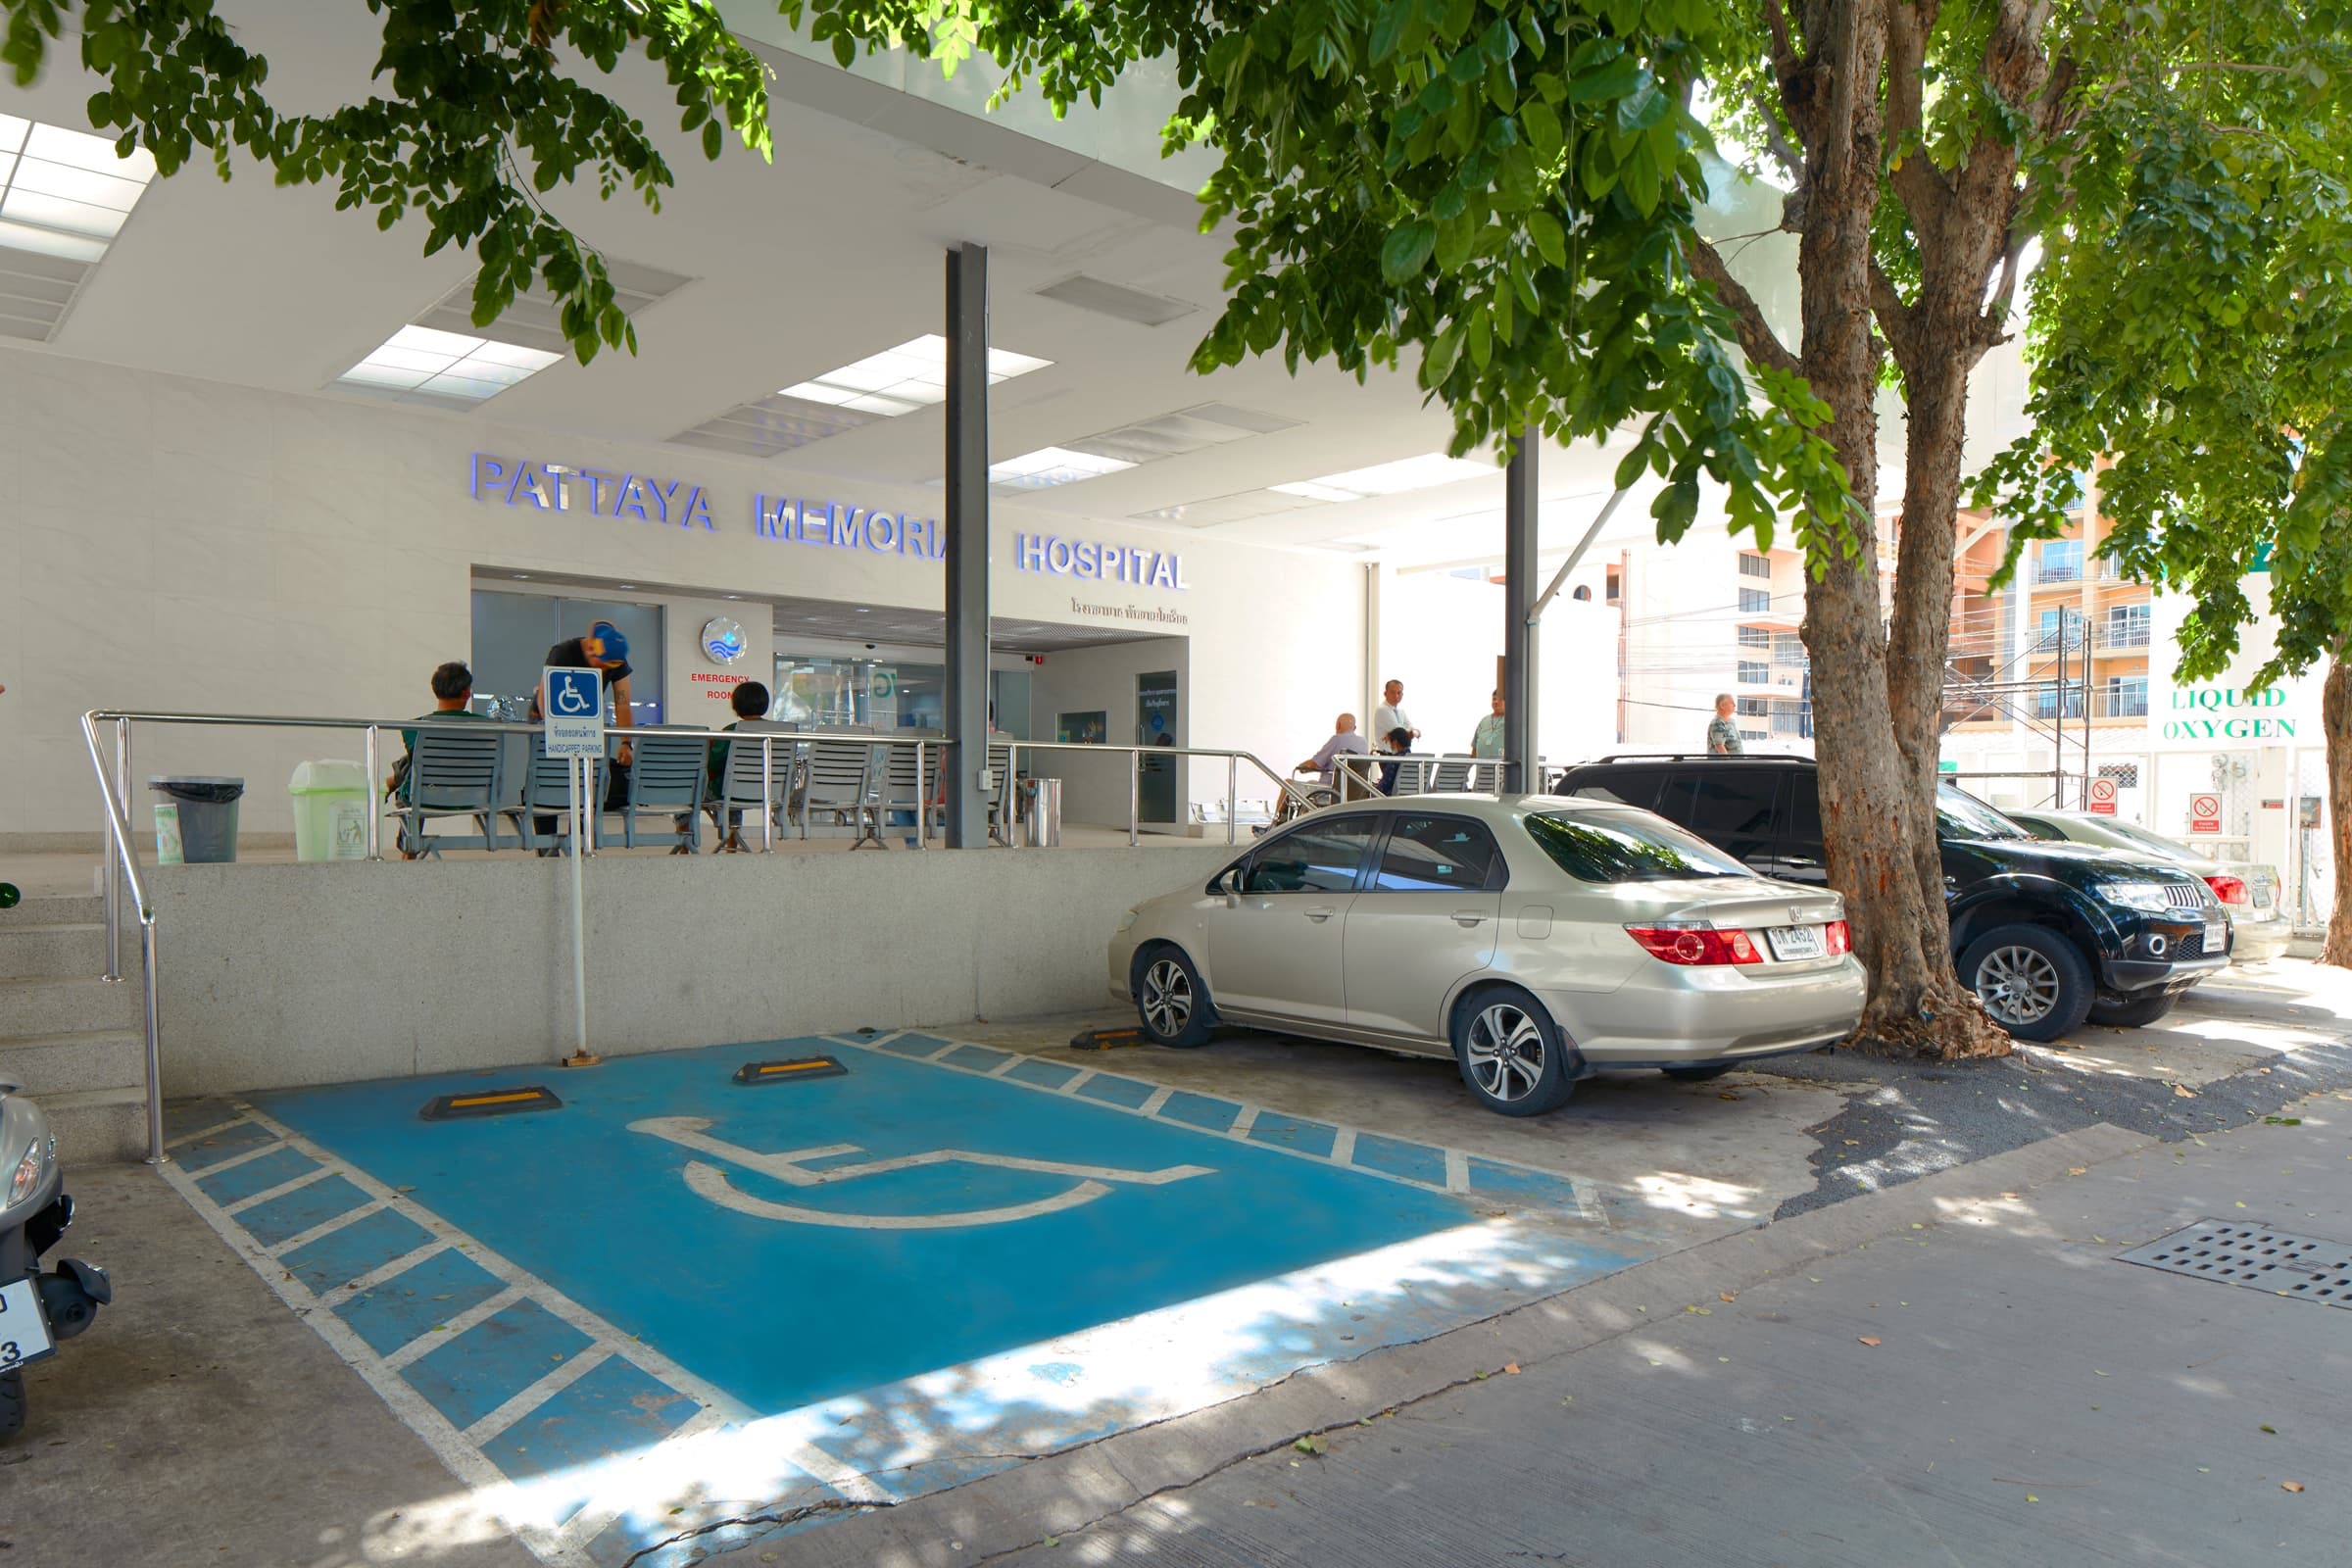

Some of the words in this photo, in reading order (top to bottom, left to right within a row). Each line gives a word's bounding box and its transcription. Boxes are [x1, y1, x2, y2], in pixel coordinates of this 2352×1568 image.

[469, 452, 719, 531] PATTAYA
[755, 493, 946, 560] MEMORI
[1016, 532, 1192, 590] HOSPITAL
[691, 673, 750, 684] EMERGENCY
[2172, 688, 2287, 712] LIQUID
[2163, 718, 2297, 740] OXYGEN
[548, 744, 580, 754] HANDICAPPED
[582, 744, 603, 754] PARKING
